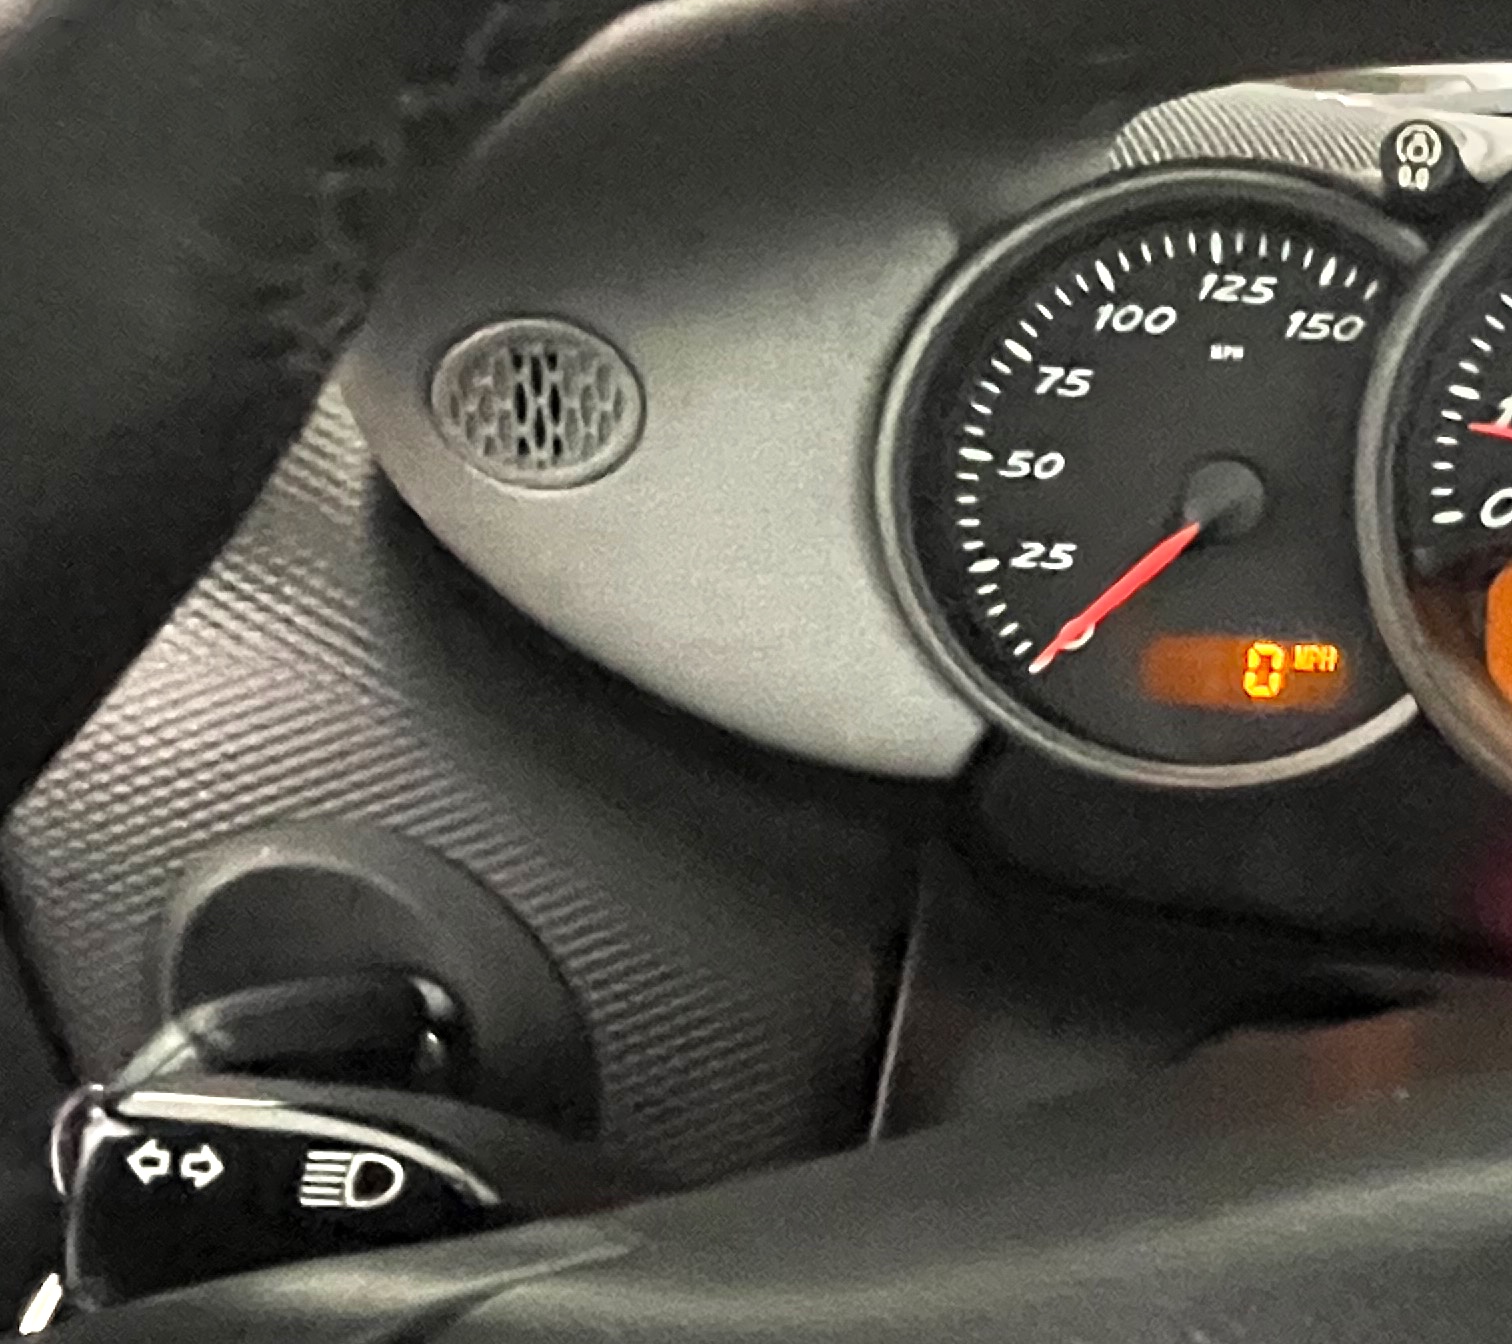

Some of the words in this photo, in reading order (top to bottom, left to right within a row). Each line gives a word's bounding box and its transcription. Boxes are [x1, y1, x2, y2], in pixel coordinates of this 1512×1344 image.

[1199, 272, 1278, 304] 125
[1095, 304, 1177, 335] 100
[1285, 309, 1366, 342] 150
[1035, 365, 1094, 398] 75
[998, 450, 1066, 480] 50
[1009, 541, 1078, 570] 25
[1243, 641, 1285, 698] 0
[1293, 644, 1338, 672] MPH
